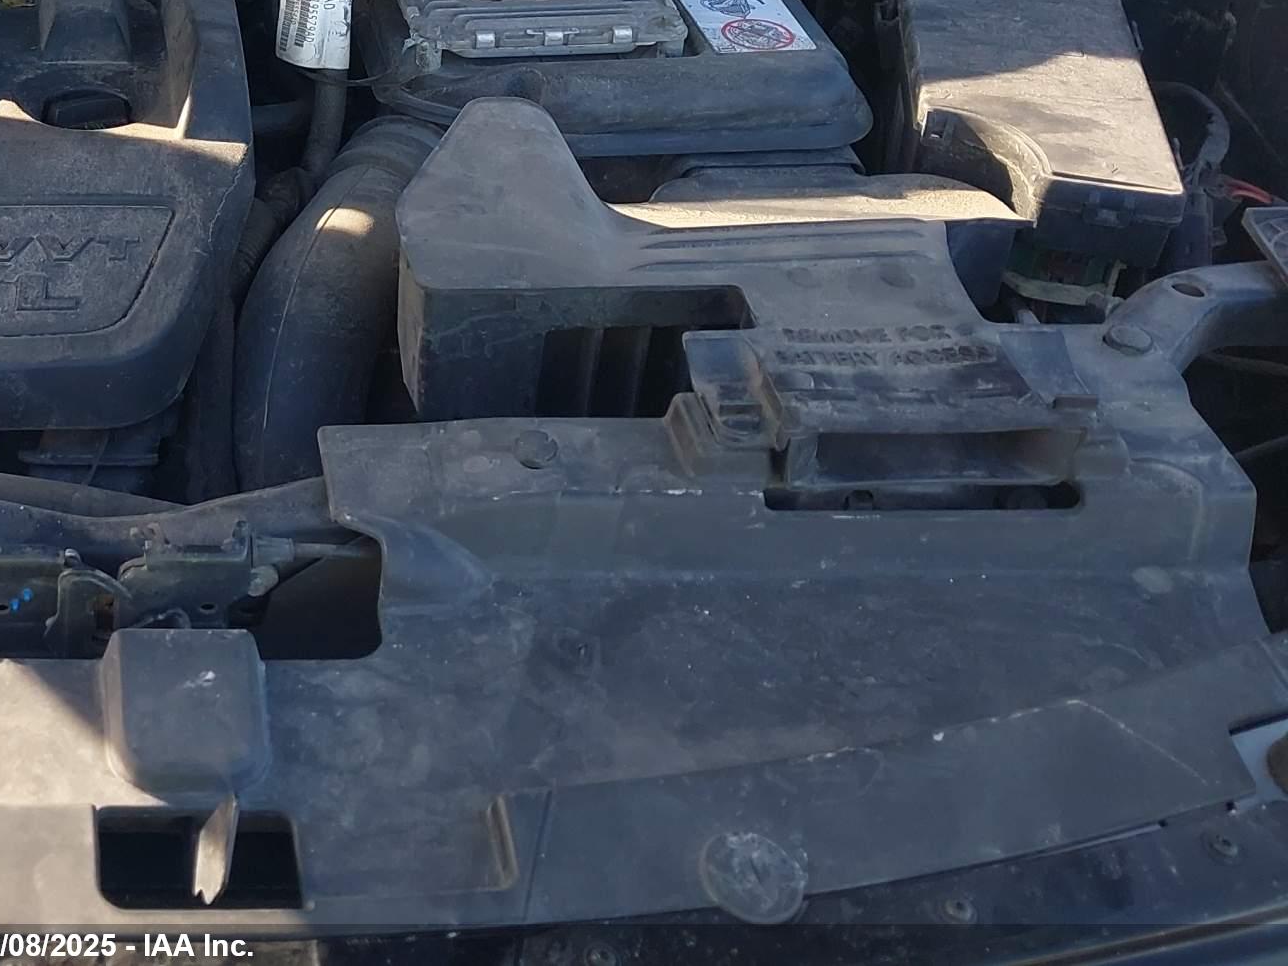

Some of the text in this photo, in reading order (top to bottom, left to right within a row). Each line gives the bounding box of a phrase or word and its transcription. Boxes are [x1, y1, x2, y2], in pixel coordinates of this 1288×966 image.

[781, 324, 952, 343] REMOVE FOR
[775, 345, 999, 366] BATTERY ACCESS
